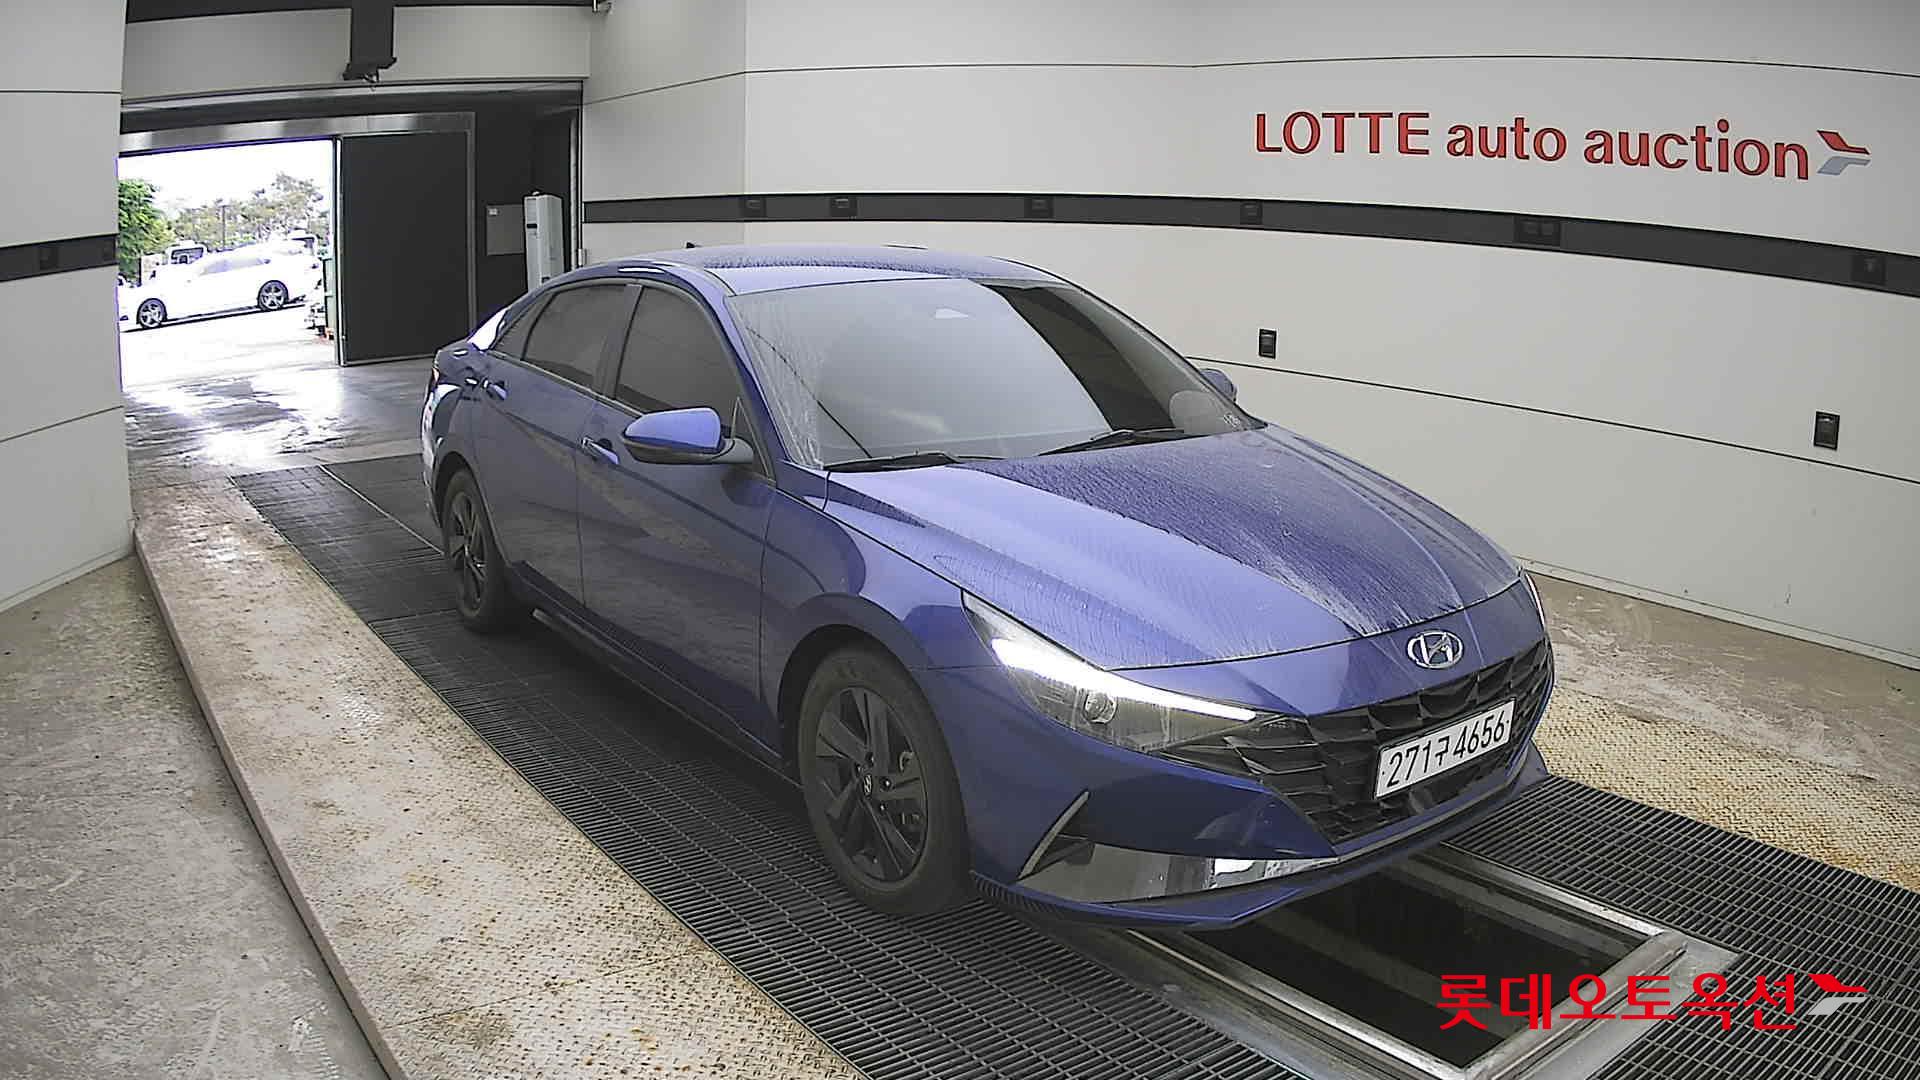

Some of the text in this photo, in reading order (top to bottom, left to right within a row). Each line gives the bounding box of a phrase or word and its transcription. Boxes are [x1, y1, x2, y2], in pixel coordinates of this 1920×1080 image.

[1255, 111, 1810, 180] LOTTE auto auction
